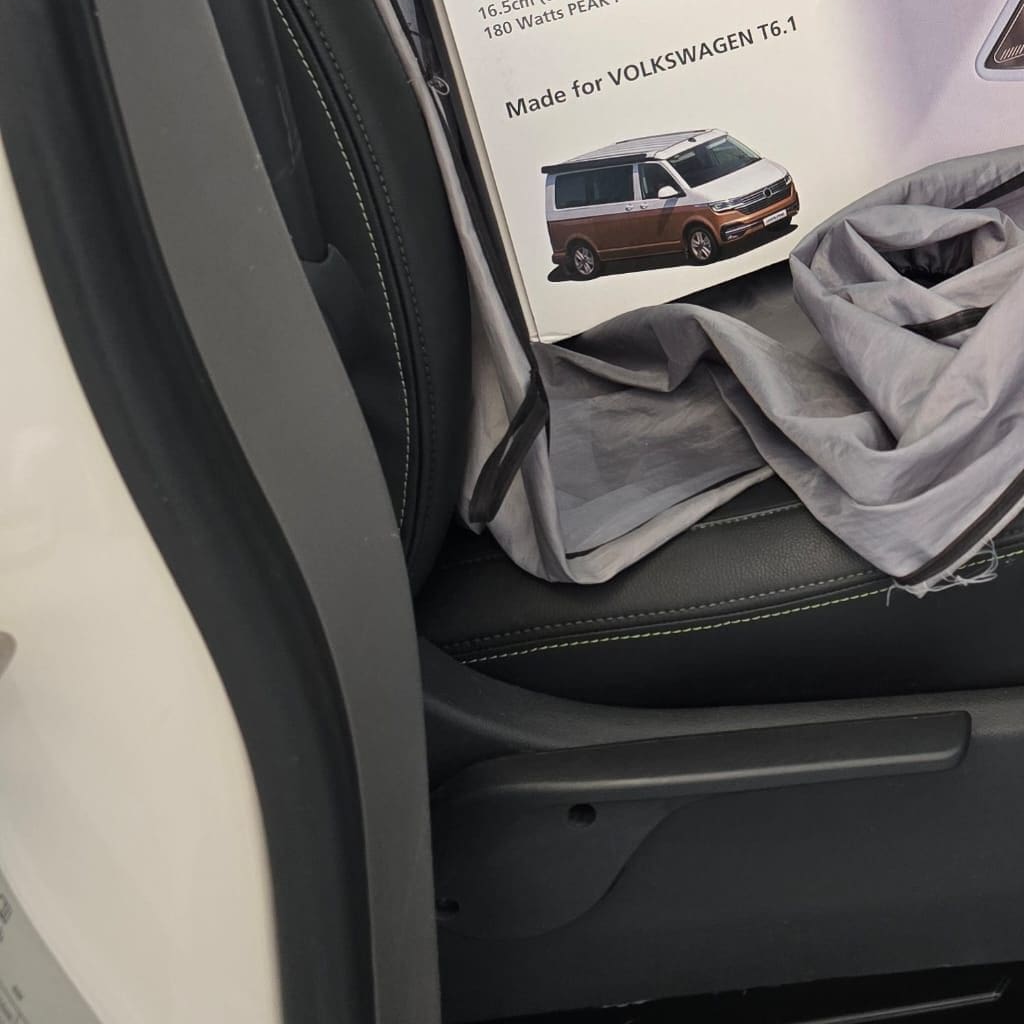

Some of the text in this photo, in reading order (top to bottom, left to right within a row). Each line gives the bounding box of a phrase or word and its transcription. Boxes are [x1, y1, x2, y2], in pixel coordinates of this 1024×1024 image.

[483, 21, 513, 39] 180
[515, 8, 565, 31] Watts
[504, 15, 799, 119] Made for VOLKSWAGEN T6.1
